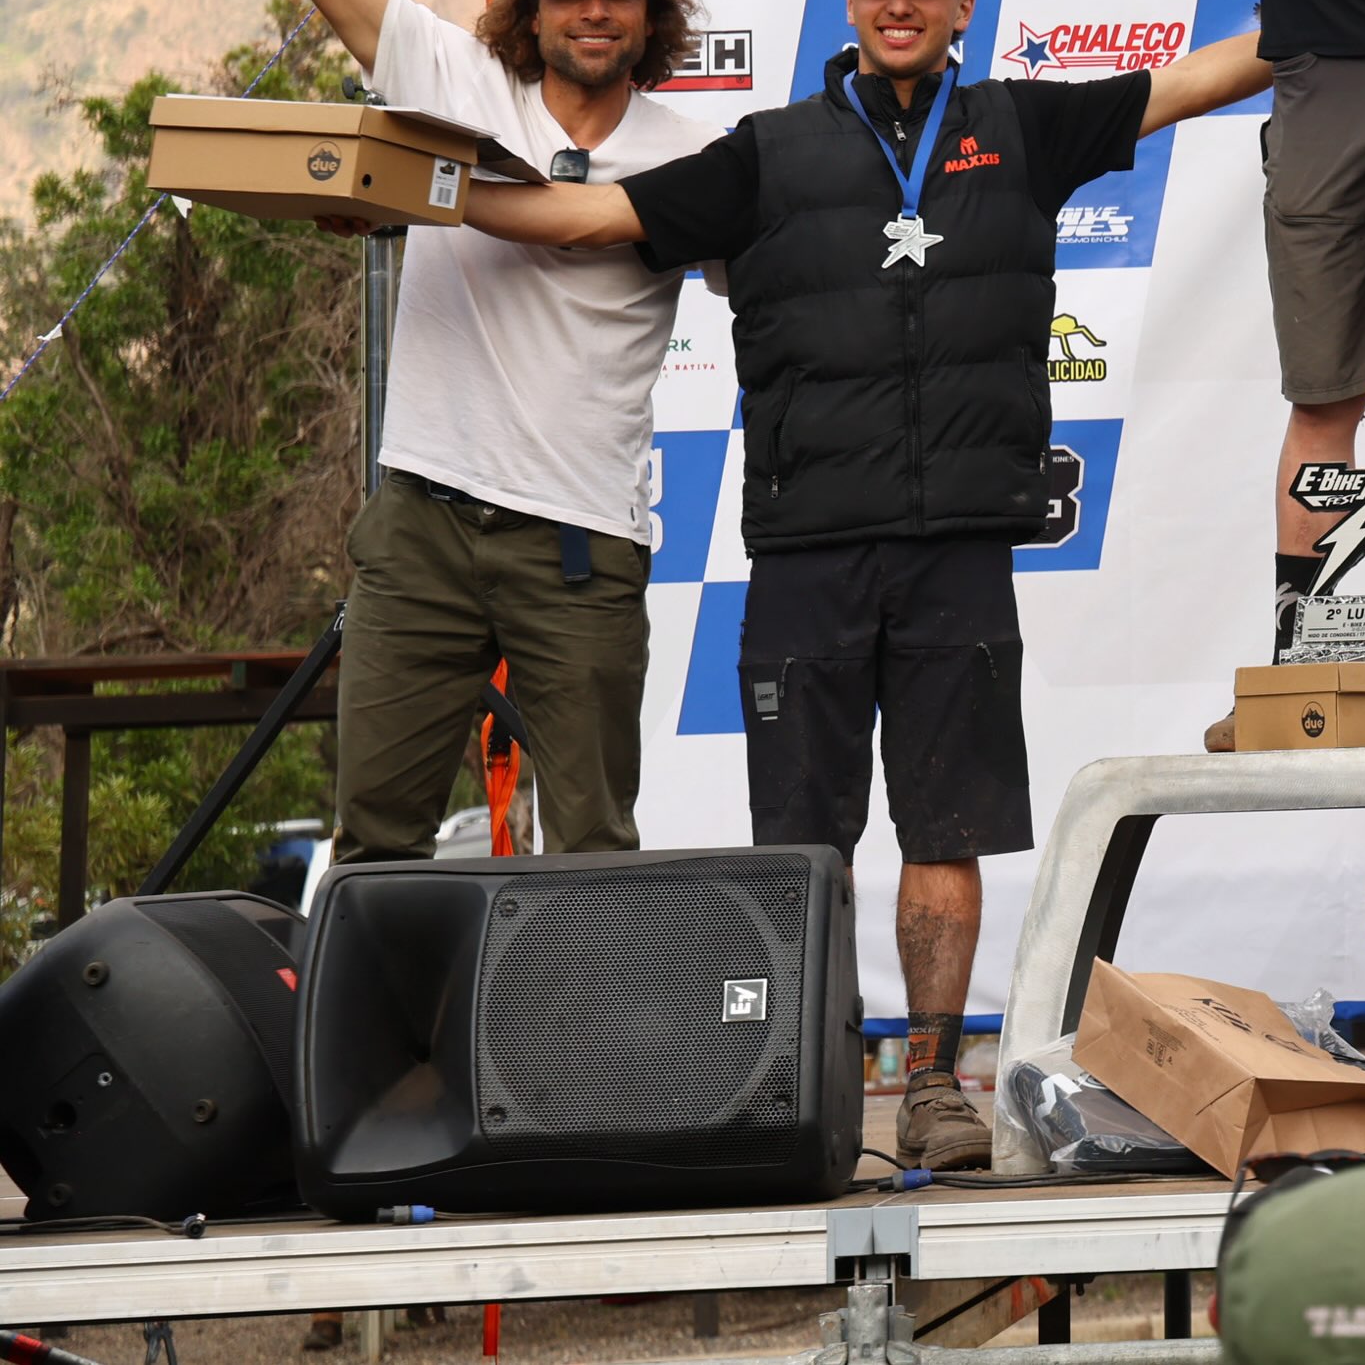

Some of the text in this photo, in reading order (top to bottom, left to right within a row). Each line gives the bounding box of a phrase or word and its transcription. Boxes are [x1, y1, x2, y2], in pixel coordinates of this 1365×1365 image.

[1049, 23, 1186, 55] CHALECO
[1114, 51, 1178, 72] LOPEZ
[310, 157, 338, 173] due
[945, 152, 1001, 174] MAXXIS
[666, 338, 692, 352] RK
[675, 363, 716, 371] NATIVA
[1048, 360, 1106, 381] LICIDAD
[1304, 717, 1324, 730] due
